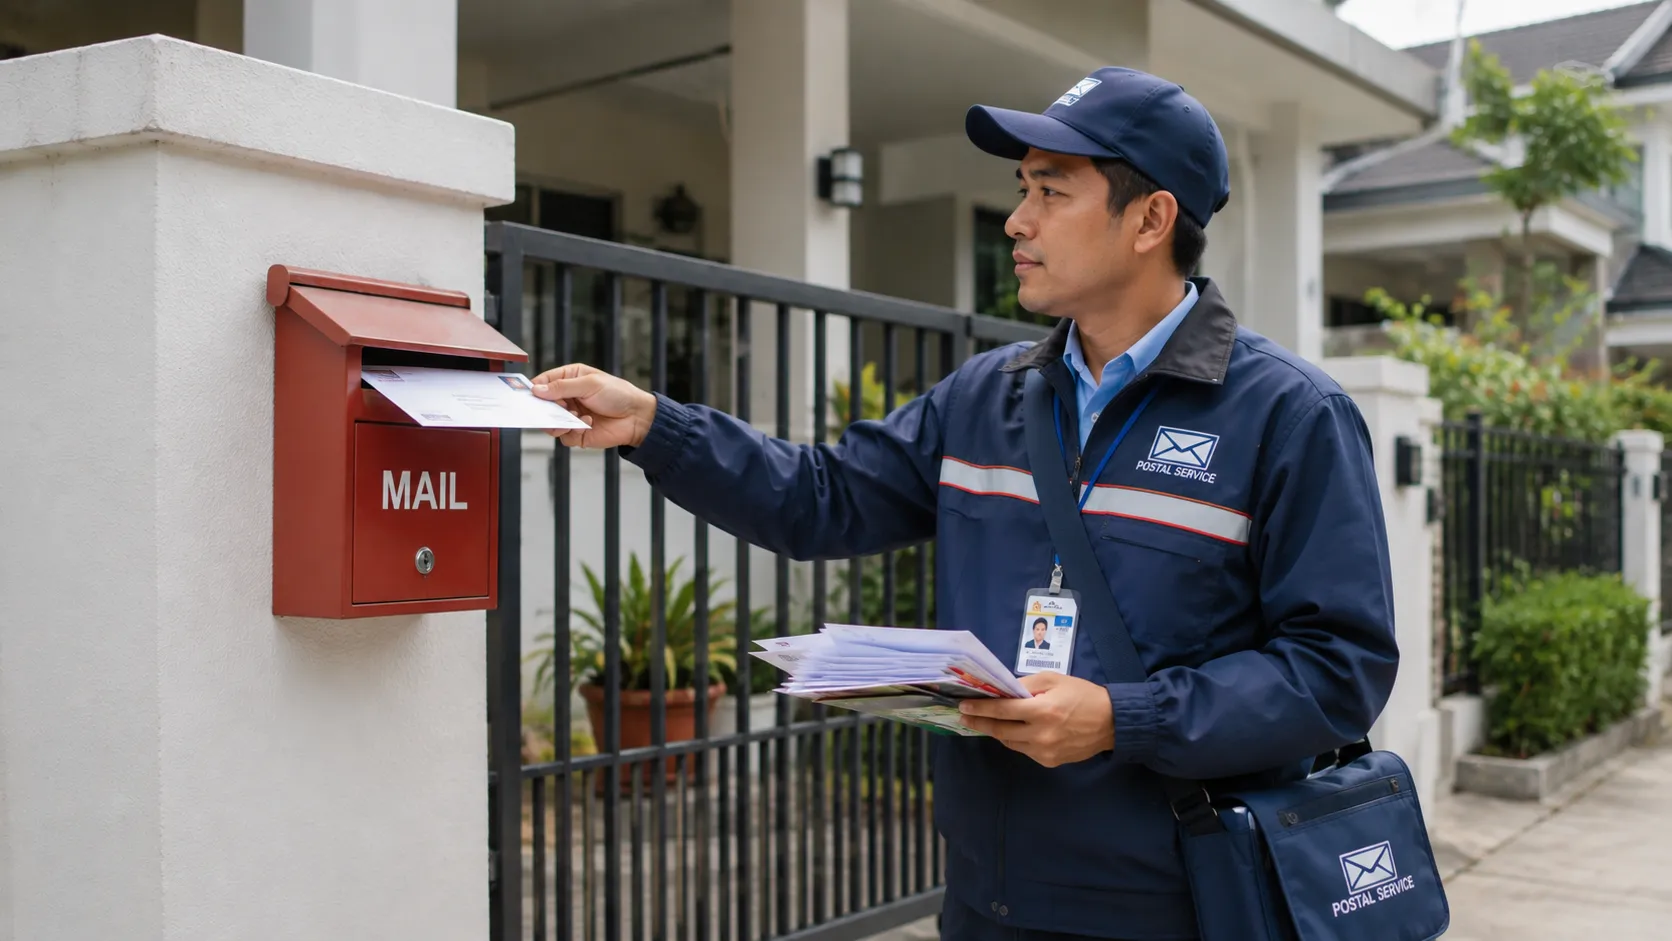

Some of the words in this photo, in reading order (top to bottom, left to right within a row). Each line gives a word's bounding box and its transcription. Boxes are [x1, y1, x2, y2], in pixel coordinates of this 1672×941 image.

[382, 470, 468, 510] MAIL
[1136, 460, 1172, 475] POSTAL
[1174, 467, 1217, 484] SERVICE
[1332, 891, 1376, 917] POSTAL
[1376, 875, 1415, 901] SERVICE
